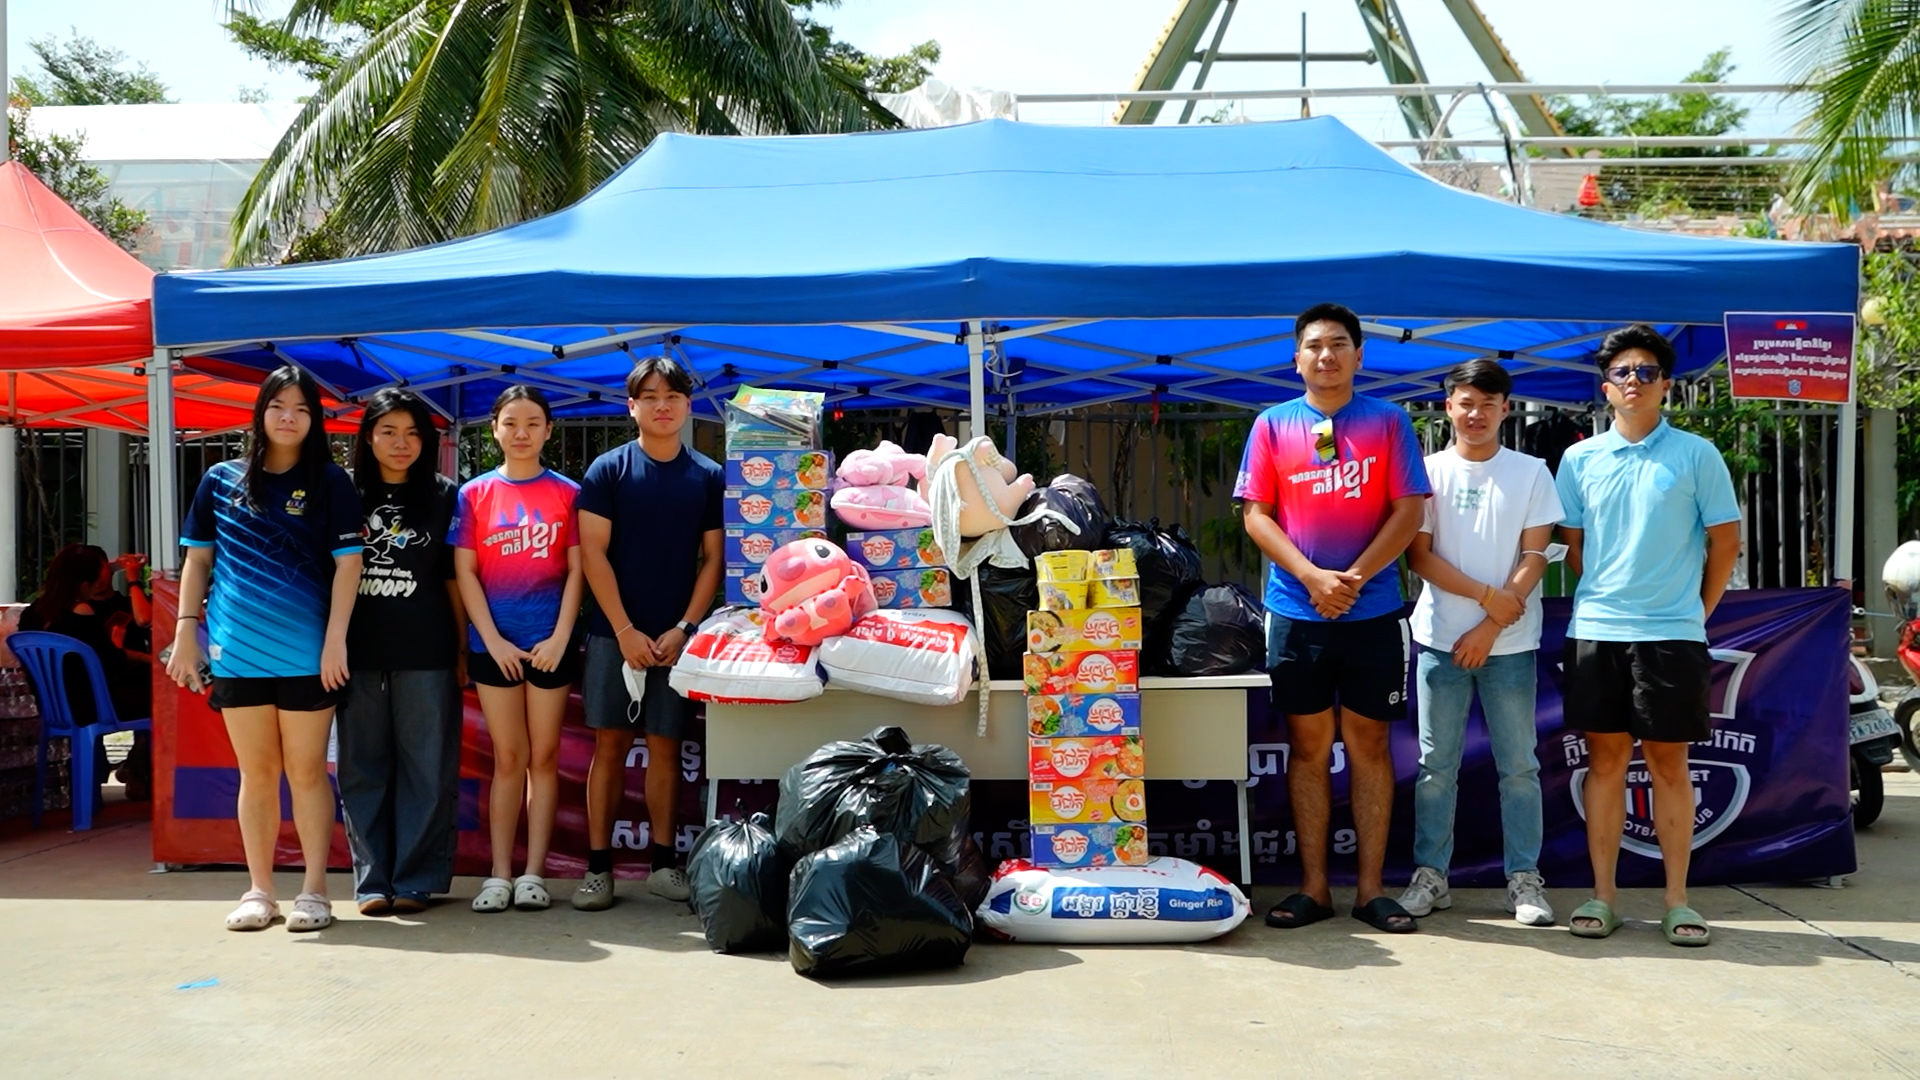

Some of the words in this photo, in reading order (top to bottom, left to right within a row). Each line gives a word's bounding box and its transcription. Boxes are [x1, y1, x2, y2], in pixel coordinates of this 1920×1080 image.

[367, 566, 392, 576] show
[358, 577, 418, 598] NOOPY
[1625, 769, 1711, 783] EUET
[1623, 820, 1658, 838] OTBA
[1693, 807, 1714, 829] UB
[1168, 898, 1205, 911] Ginger
